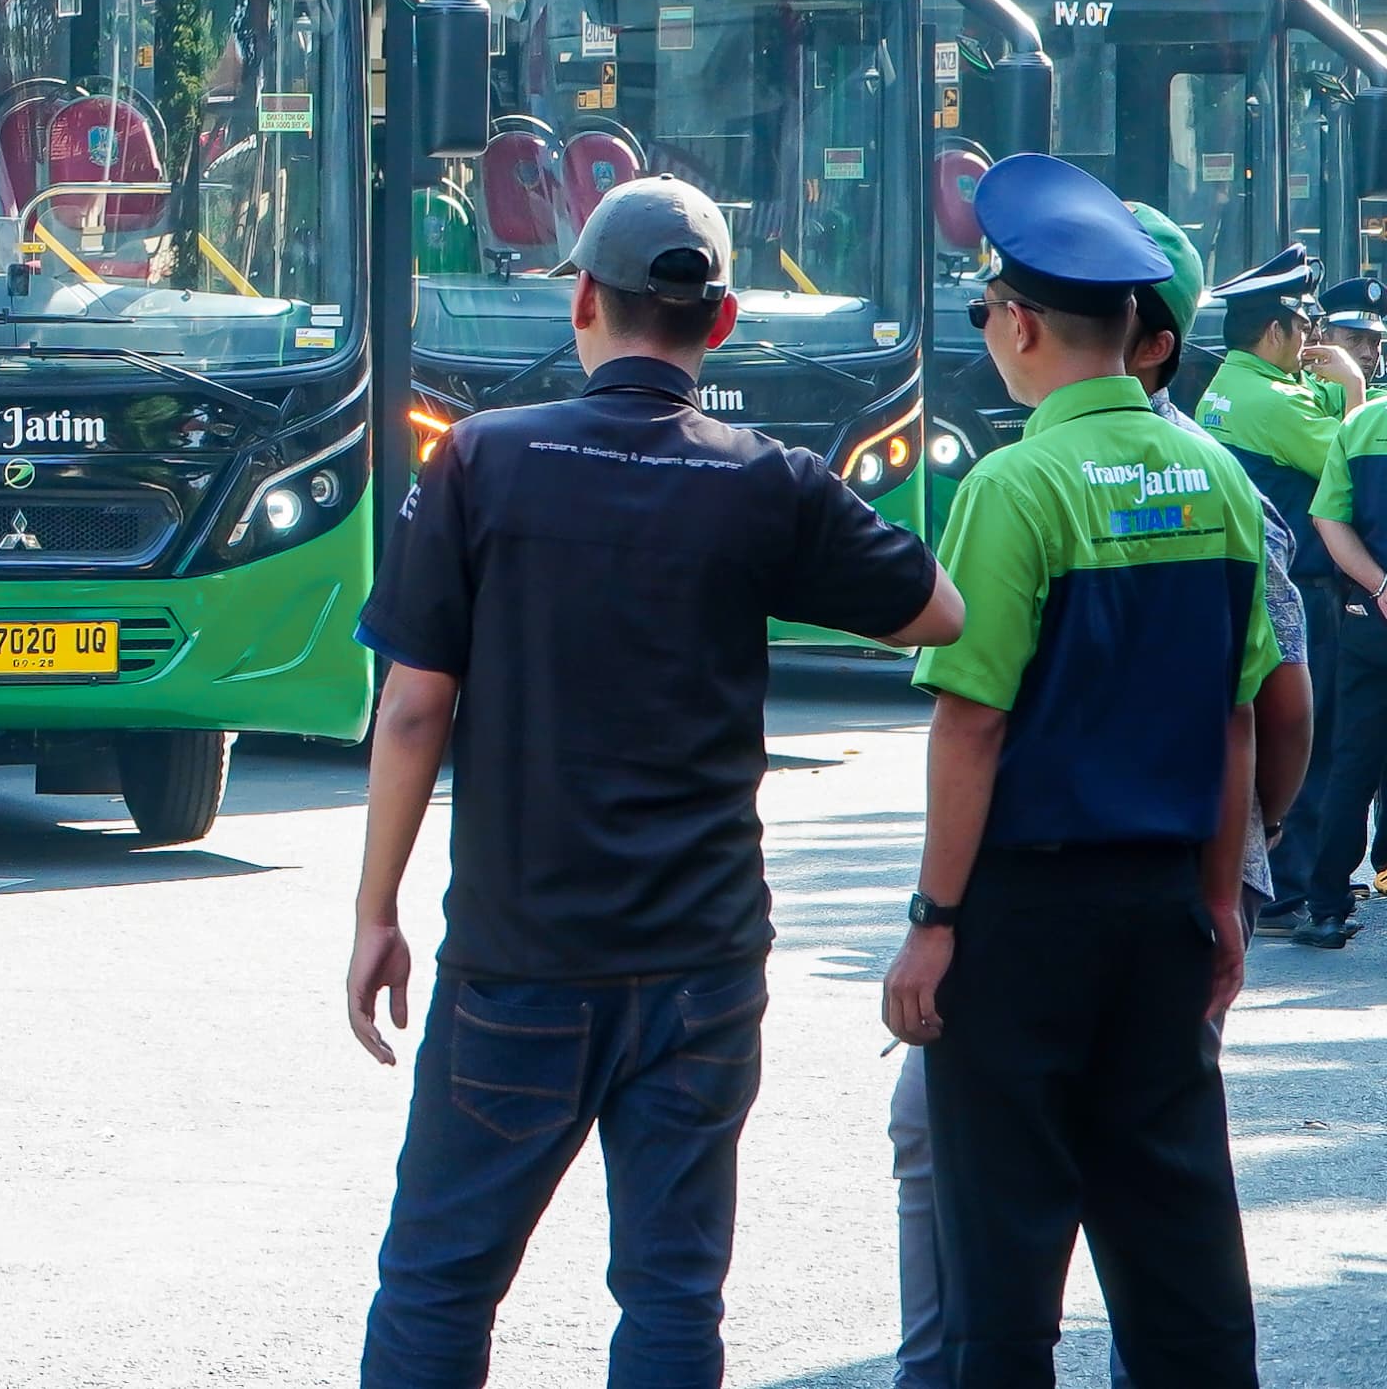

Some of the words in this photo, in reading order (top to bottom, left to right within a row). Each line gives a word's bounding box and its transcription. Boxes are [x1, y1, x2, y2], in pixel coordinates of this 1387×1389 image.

[1055, 0, 1114, 27] IV.07
[699, 384, 745, 411] tim
[2, 407, 107, 449] Jatim
[1082, 460, 1134, 485] Trans
[1132, 462, 1211, 504] Jatim
[76, 627, 107, 653] UQ
